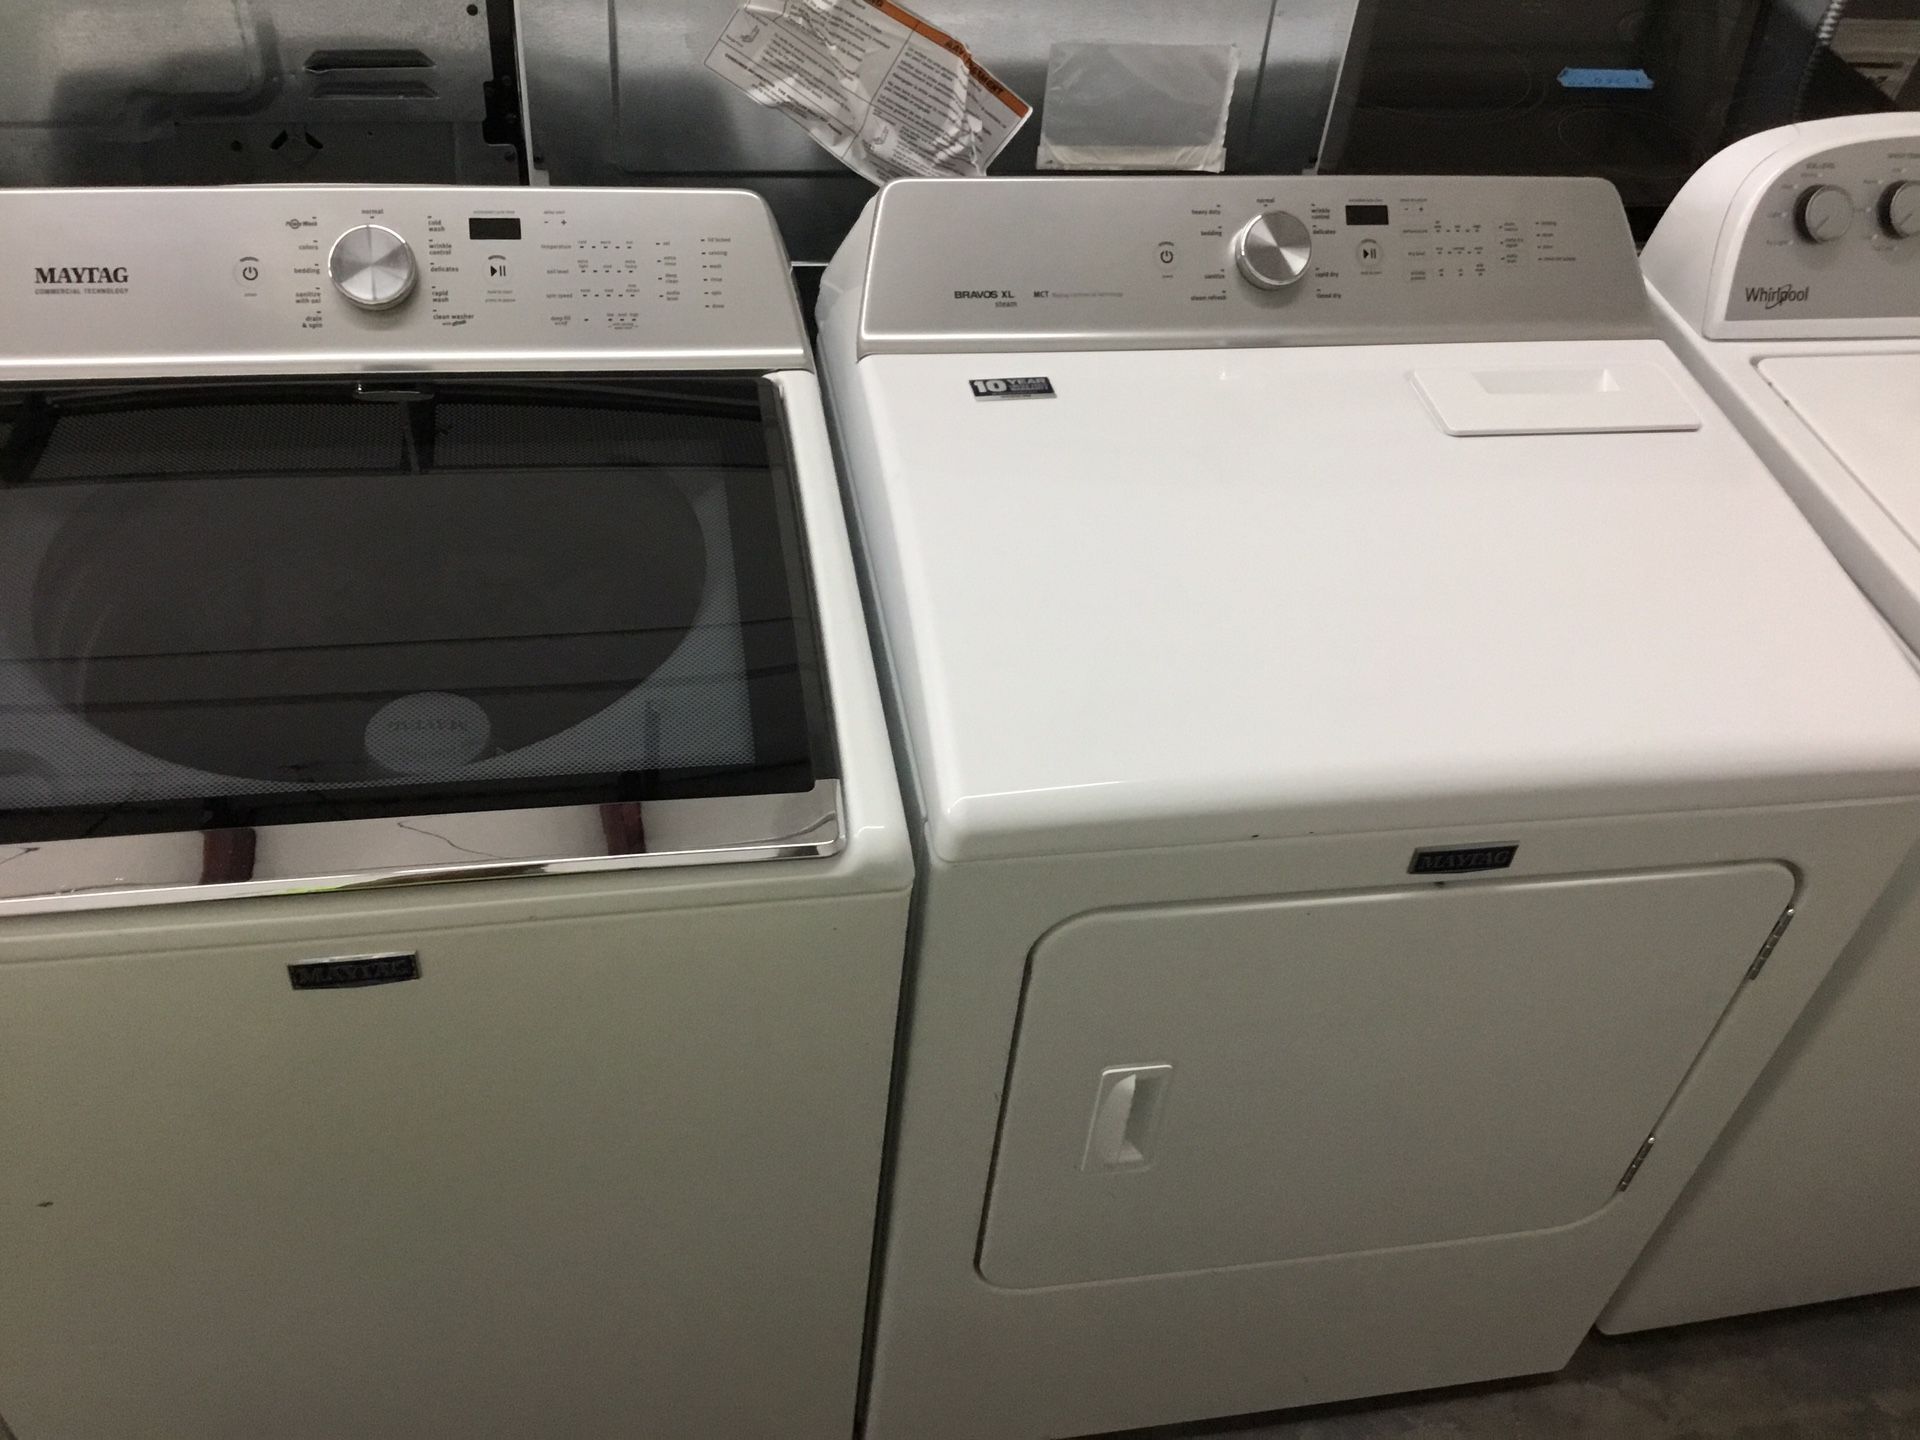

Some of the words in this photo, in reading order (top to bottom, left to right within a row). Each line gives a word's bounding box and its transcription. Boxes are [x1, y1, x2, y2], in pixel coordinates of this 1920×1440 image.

[34, 267, 129, 284] MAYTAG
[34, 287, 81, 295] COMMERCIAL
[84, 287, 129, 295] TECHNOLOGY
[954, 290, 999, 299] BRAVOS
[1001, 290, 1015, 299] XL
[1745, 284, 1810, 308] Whirlpool
[973, 379, 1008, 393] 10
